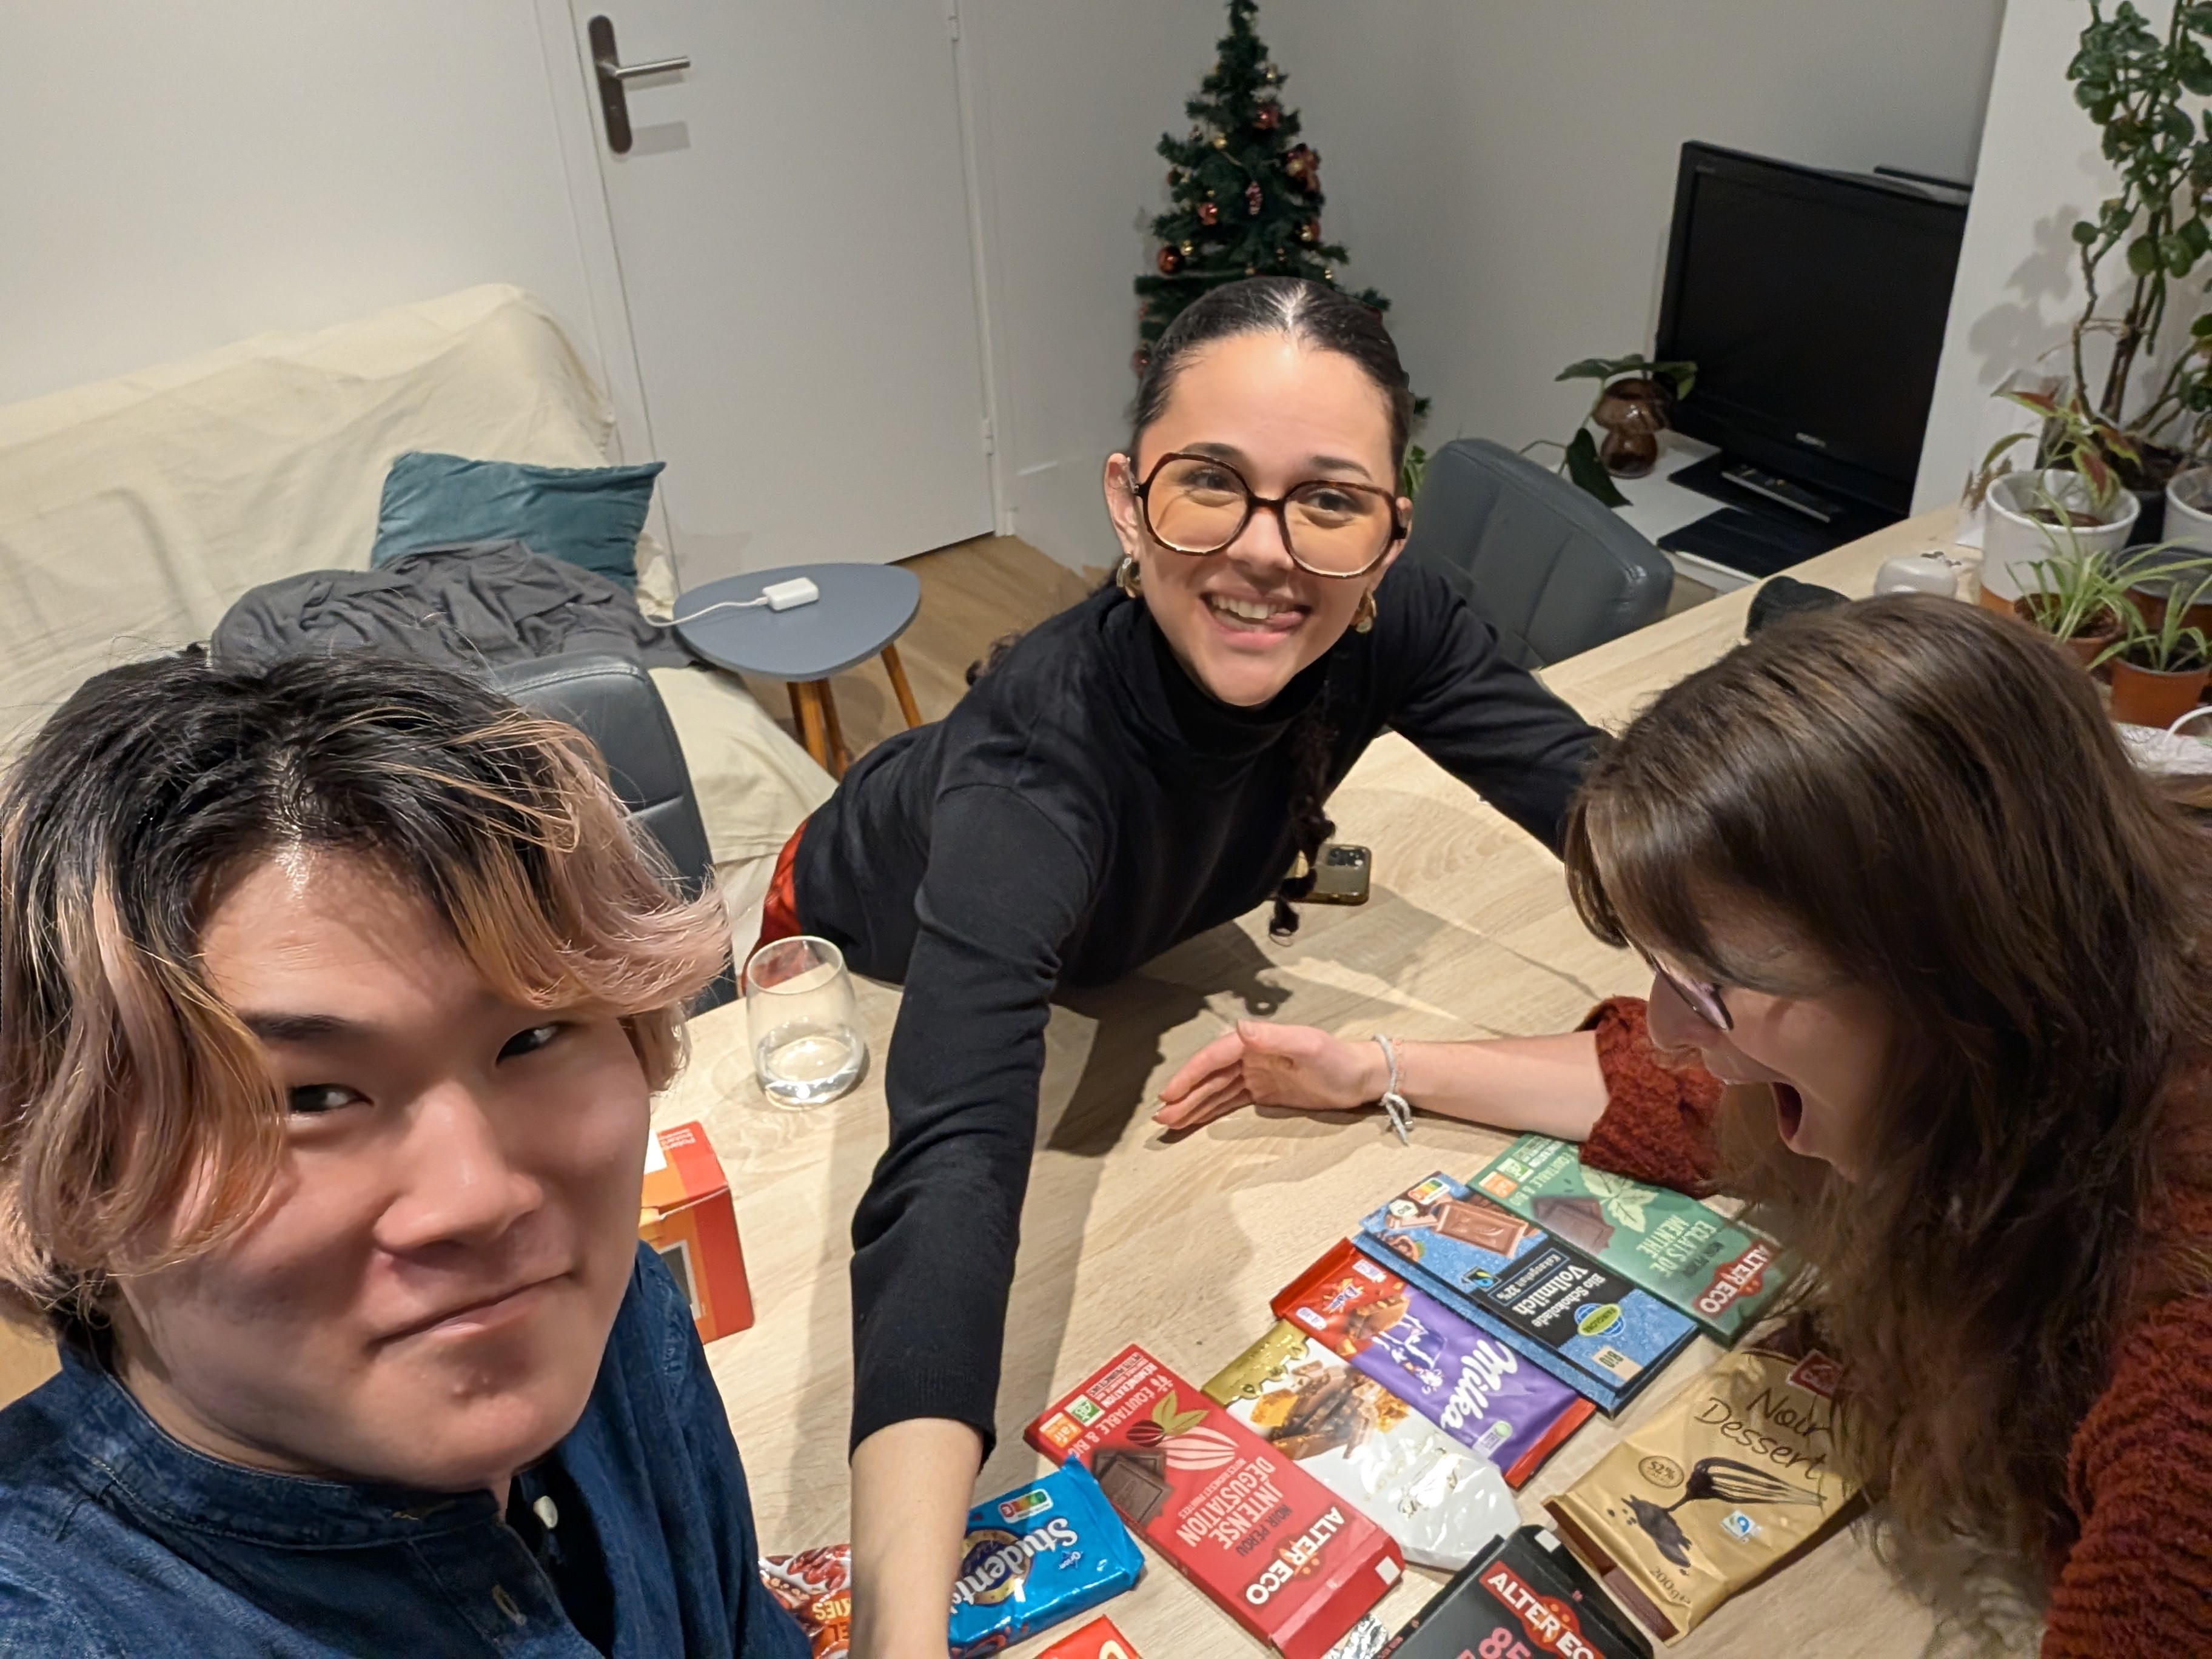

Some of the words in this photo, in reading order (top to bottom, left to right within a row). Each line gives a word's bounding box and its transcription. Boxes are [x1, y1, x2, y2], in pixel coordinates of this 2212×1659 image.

[1583, 1273, 1606, 1288] Bio
[1732, 1244, 1771, 1285] ALTER
[1512, 1265, 1589, 1315] Vollmilch
[1531, 1286, 1589, 1327] Schokolade
[1700, 1281, 1738, 1313] ECO
[1440, 1339, 1518, 1429] Milka
[1746, 1387, 1831, 1437] Noir
[1085, 1431, 1100, 1443] &
[1694, 1396, 1827, 1480] Dessert
[1649, 1460, 1676, 1481] 52%
[1208, 1480, 1283, 1550] INTENSE
[1267, 1504, 1292, 1528] NOIR
[1291, 1507, 1345, 1565] ALTER
[1246, 1560, 1294, 1604] ECO
[1487, 1573, 1560, 1641] ALTER
